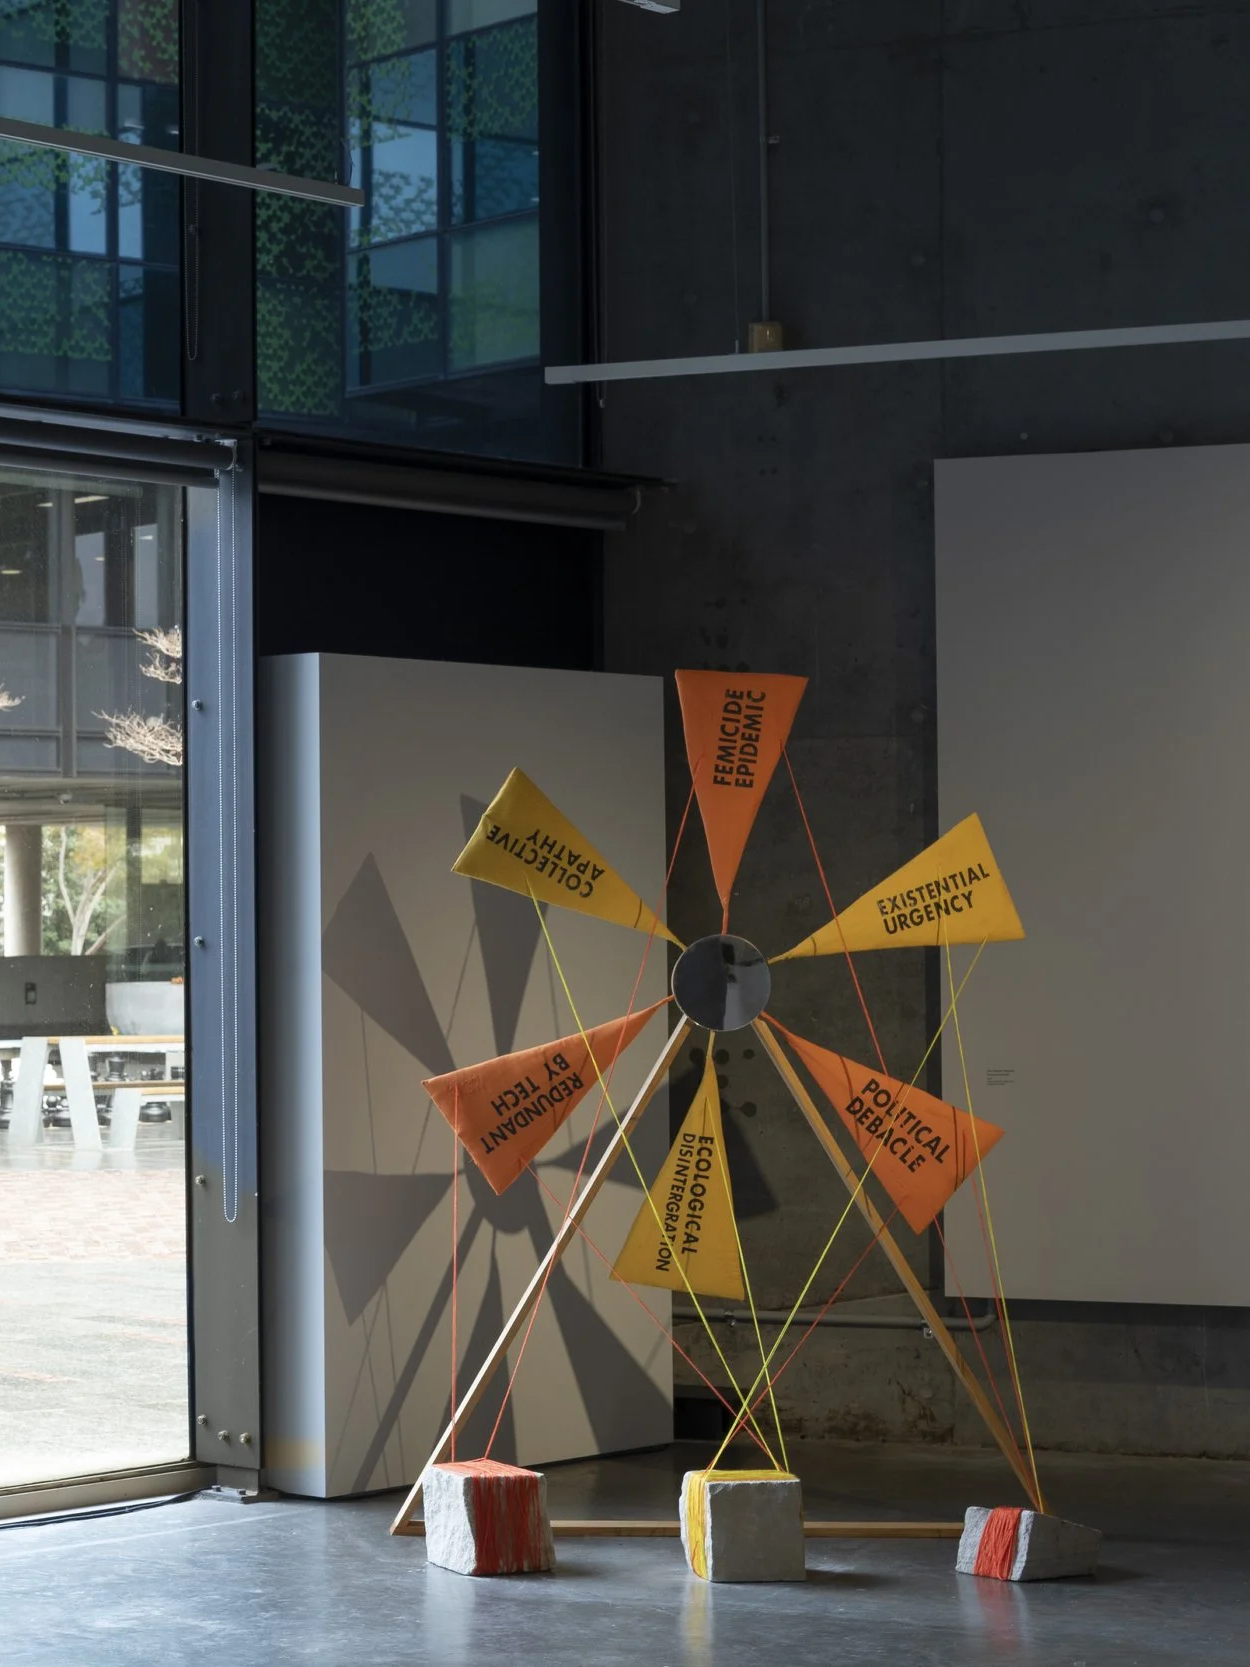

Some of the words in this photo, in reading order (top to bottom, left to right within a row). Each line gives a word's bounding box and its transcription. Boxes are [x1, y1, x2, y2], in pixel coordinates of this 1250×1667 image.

[712, 688, 744, 787] FEMICIDE
[734, 690, 767, 788] EPIDEMIC
[486, 824, 594, 898] COLLECTIVE
[525, 828, 605, 881] APATHY
[876, 863, 990, 917] EXISTENTIAL
[882, 890, 973, 935] URGENCY
[491, 1076, 540, 1117] TECH
[543, 1052, 570, 1082] BY
[480, 1072, 584, 1154] REDUNDANT
[846, 1096, 927, 1173] DEBACLE
[861, 1078, 950, 1164] POLITICAL
[655, 1133, 696, 1272] DISINTERGRATION
[681, 1135, 715, 1254] ECOLOGICAL
